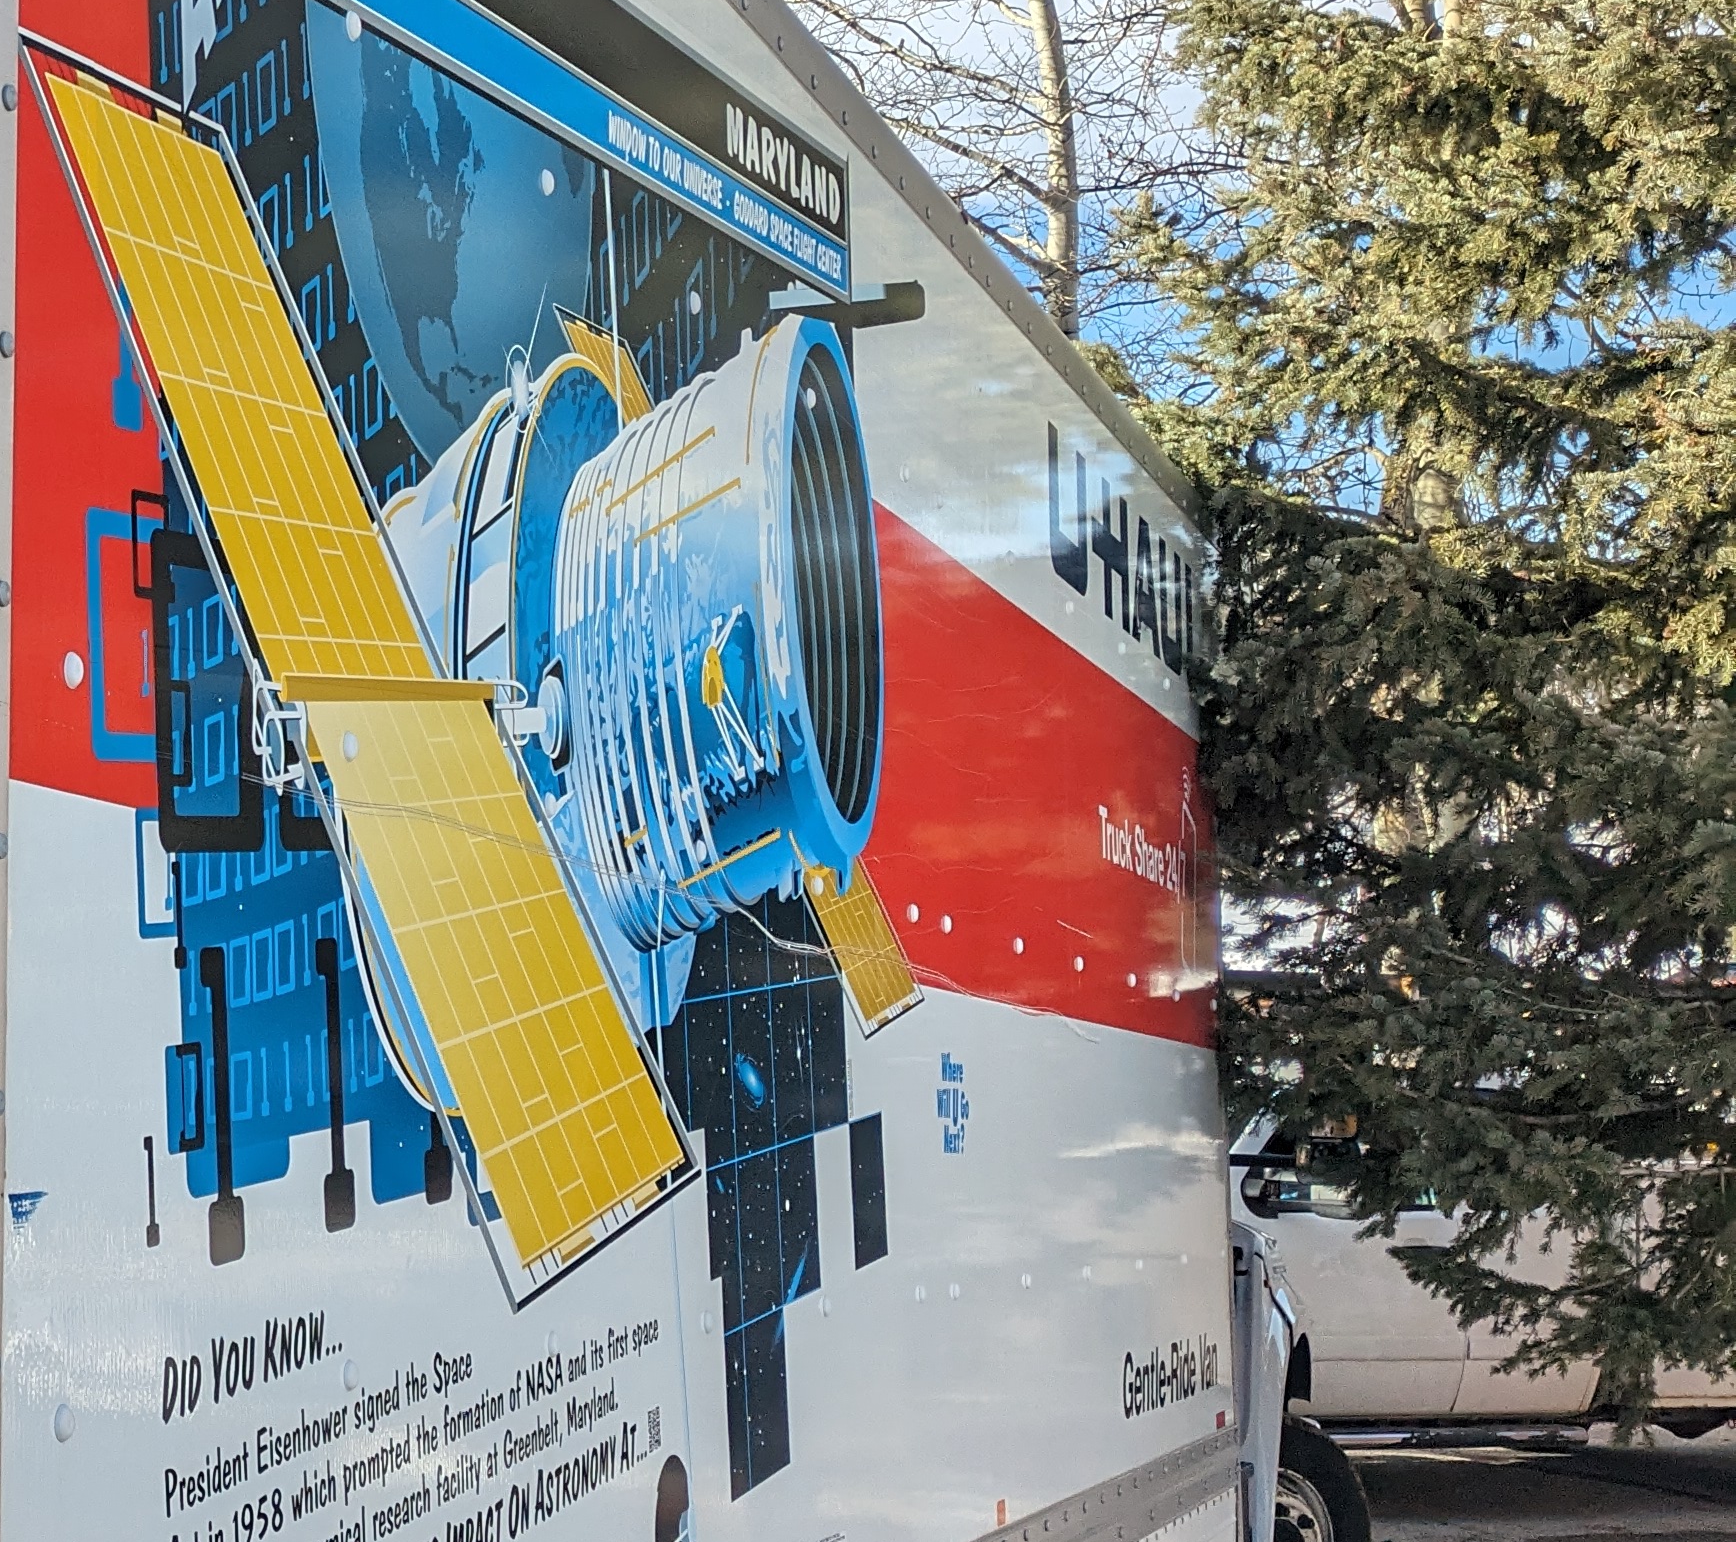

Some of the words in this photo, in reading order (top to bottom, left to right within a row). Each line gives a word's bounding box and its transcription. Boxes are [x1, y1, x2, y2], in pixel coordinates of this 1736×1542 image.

[609, 110, 646, 161] WINDOW
[649, 136, 660, 171] TO
[663, 145, 682, 186] OUR
[684, 157, 722, 210] UNIVERSE
[733, 190, 768, 237] GODDARD
[770, 212, 792, 252] SPACE
[793, 227, 815, 268] FLIGHT
[817, 243, 842, 282] CENTER
[726, 103, 840, 225] MARYLAND
[1099, 804, 1134, 871] Truck
[1134, 823, 1164, 887] Share
[952, 1088, 958, 1127] U
[961, 1091, 969, 1120] Go
[162, 1356, 202, 1424] DID
[211, 1336, 255, 1404] YOU
[263, 1309, 343, 1382] KNOW...
[291, 1460, 336, 1522] which
[343, 1424, 410, 1506] prompted
[417, 1416, 438, 1462] the
[443, 1388, 504, 1447] formation
[509, 1369, 522, 1410] of
[526, 1352, 563, 1407] NASA
[568, 1341, 586, 1383] and
[591, 1337, 604, 1370] its
[608, 1323, 628, 1363] first
[632, 1317, 659, 1356] space
[1123, 1339, 1196, 1419] Gentle-Ride
[1199, 1332, 1218, 1391] Van
[165, 1440, 249, 1517] President
[256, 1406, 348, 1474] Eisenhower
[354, 1370, 400, 1434] signed
[406, 1362, 428, 1405] the
[433, 1351, 472, 1396] Space
[372, 1473, 430, 1542] research
[436, 1450, 481, 1508] facility
[486, 1444, 498, 1479] at
[503, 1409, 563, 1470] Greenbelt,
[567, 1378, 618, 1438] Maryland.
[508, 1483, 529, 1541] ON
[534, 1434, 616, 1525] ASTRONOMY
[620, 1422, 648, 1474] AT...
